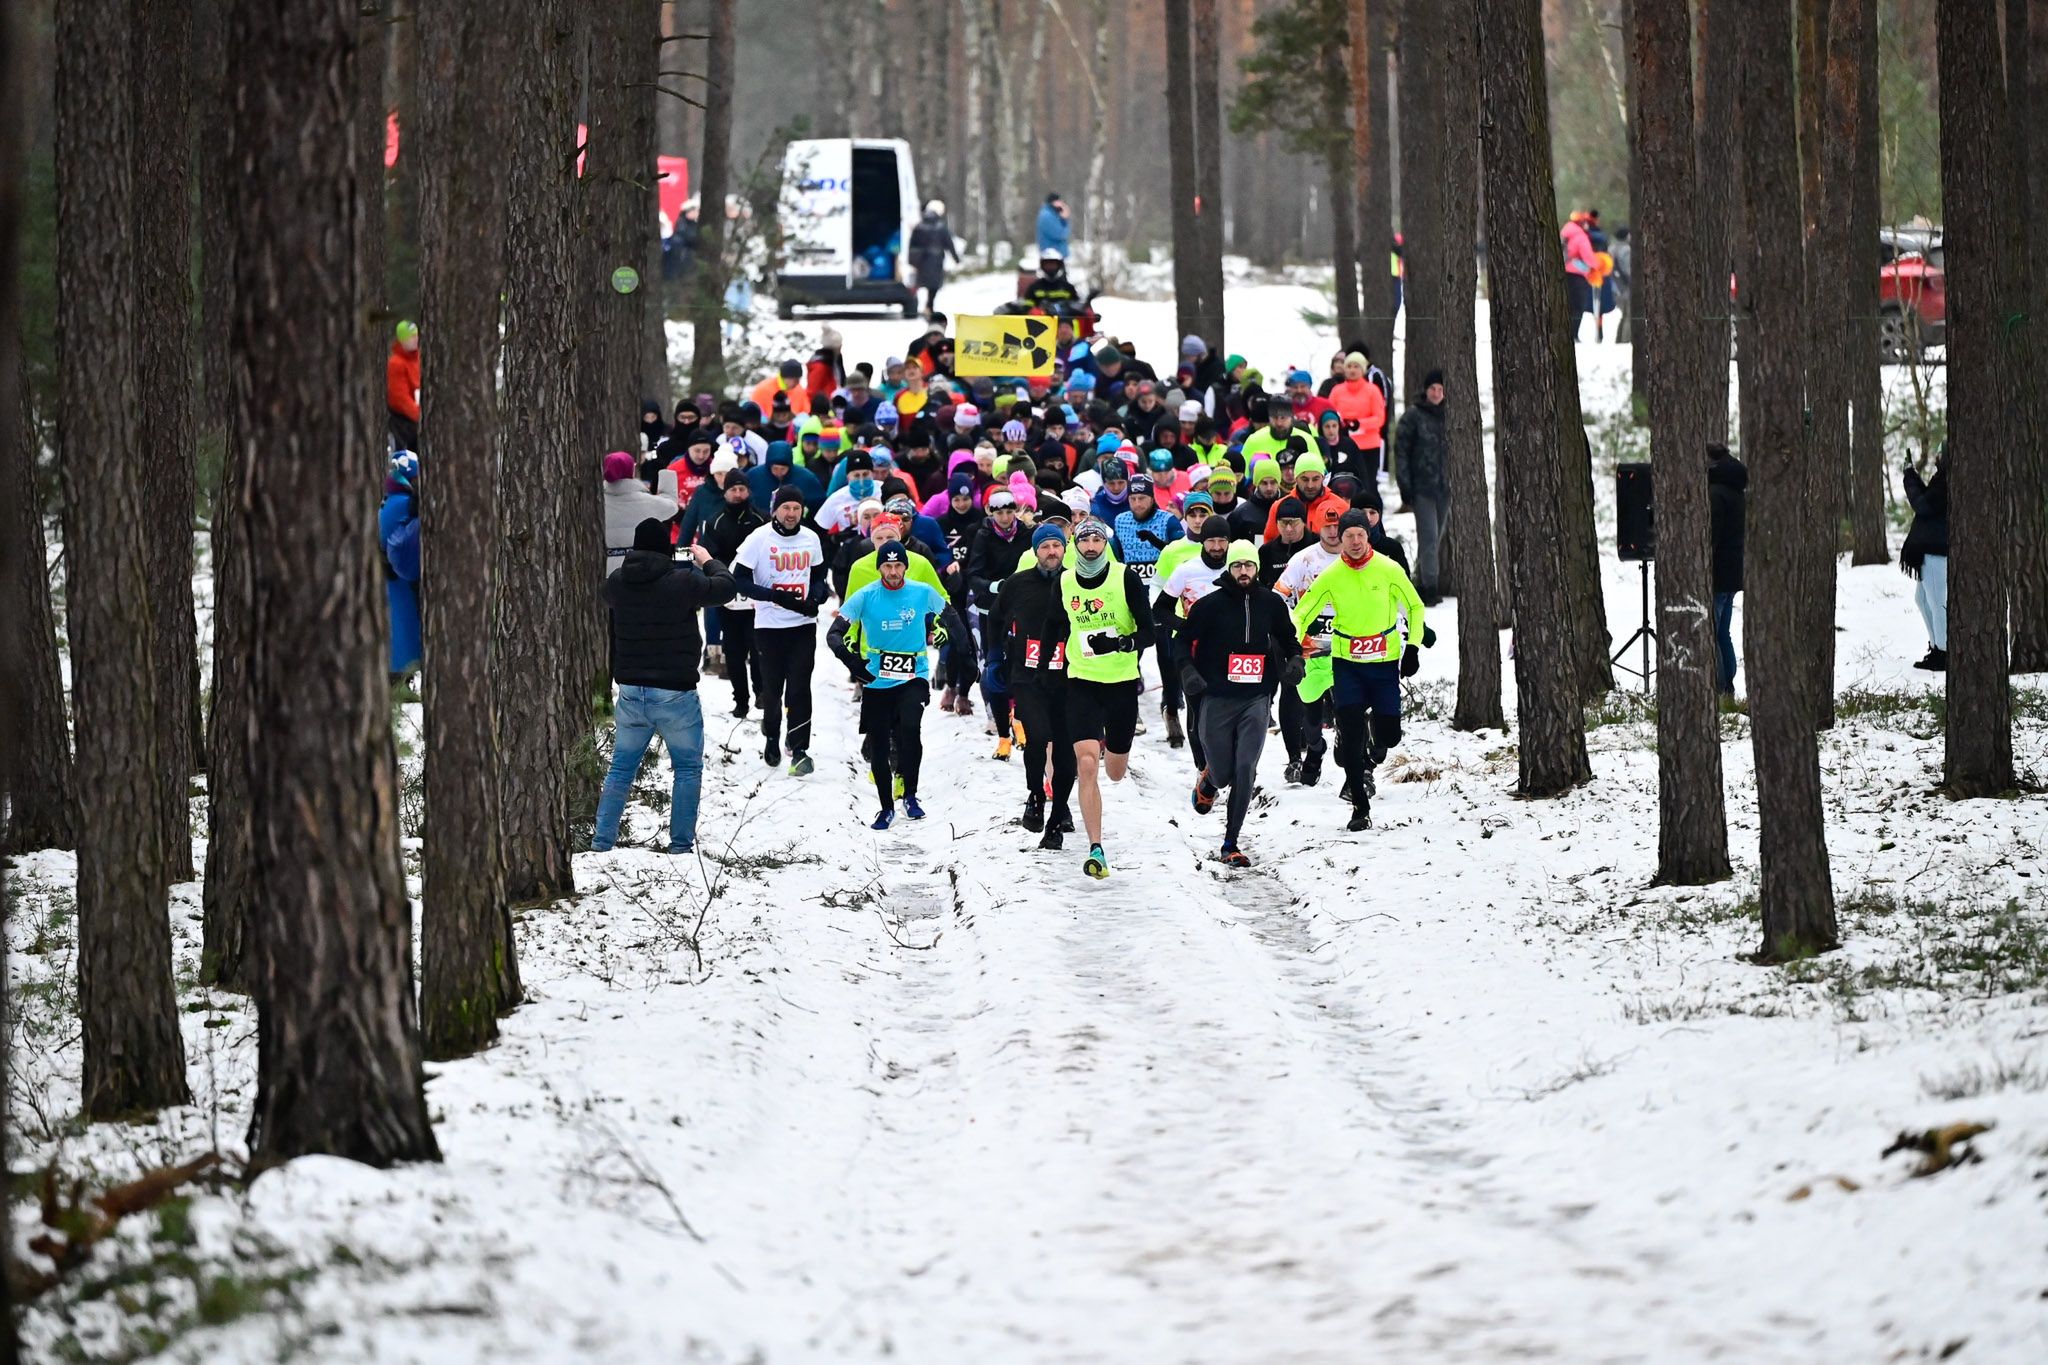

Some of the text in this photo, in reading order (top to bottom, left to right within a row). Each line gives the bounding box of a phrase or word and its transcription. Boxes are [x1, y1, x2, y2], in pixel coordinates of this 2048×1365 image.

[1076, 615, 1091, 624] RUN
[1352, 637, 1383, 654] 227
[882, 655, 913, 672] 524
[1231, 657, 1262, 674] 263
